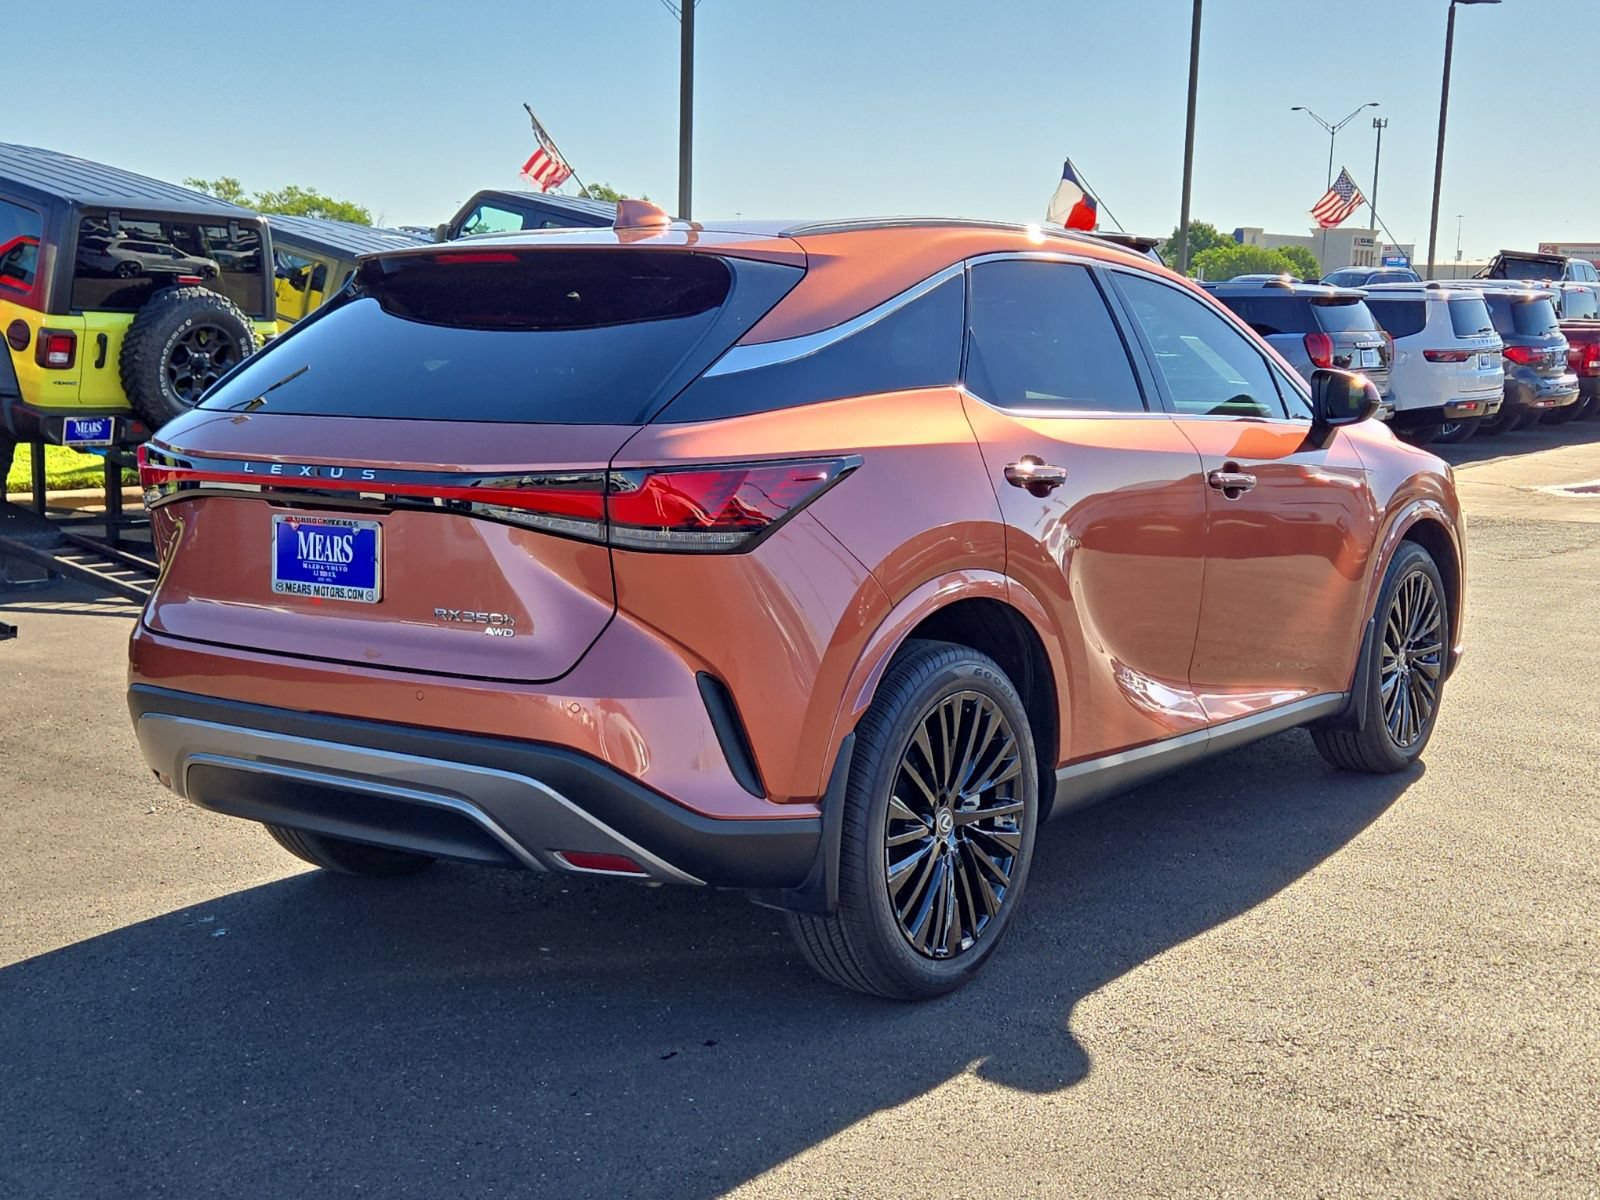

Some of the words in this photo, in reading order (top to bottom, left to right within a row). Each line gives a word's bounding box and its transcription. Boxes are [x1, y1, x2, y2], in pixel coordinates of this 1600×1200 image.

[75, 421, 103, 434] MEARS
[243, 462, 376, 479] LEXUS
[297, 530, 354, 563] MEARS
[284, 583, 312, 596] MEARS
[313, 587, 365, 601] MOTORS.COM
[484, 626, 516, 638] AWD
